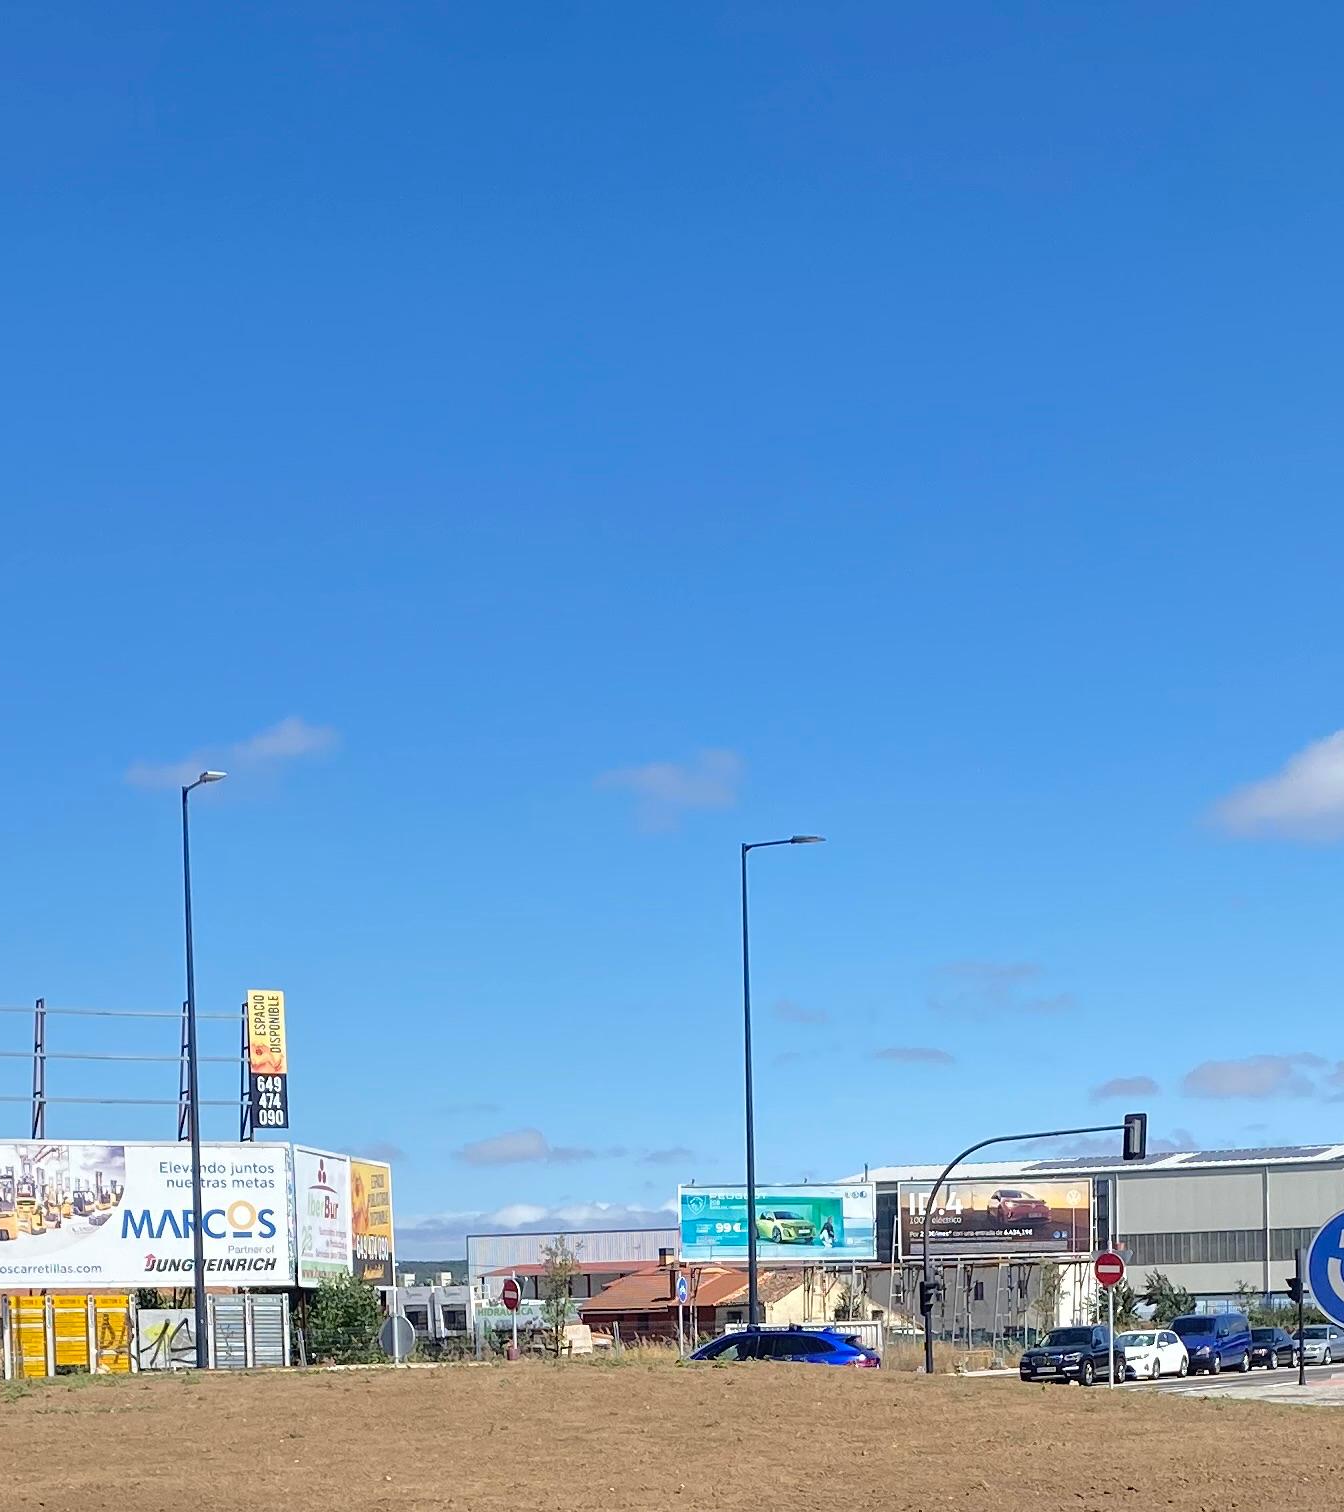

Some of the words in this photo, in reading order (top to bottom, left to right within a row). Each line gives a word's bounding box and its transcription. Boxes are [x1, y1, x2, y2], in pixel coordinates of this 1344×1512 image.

[252, 994, 267, 1036] ESPACIO
[267, 995, 282, 1054] DISPONIBLE
[256, 1075, 282, 1092] 649
[258, 1092, 282, 1109] 474
[258, 1109, 284, 1126] 090
[230, 1161, 275, 1176] juntos
[166, 1178, 227, 1188] nuetras
[232, 1178, 275, 1188] metas
[121, 1200, 276, 1239] MARCOS
[715, 1222, 732, 1233] 99
[227, 1244, 262, 1254] Partner
[265, 1244, 275, 1254] of
